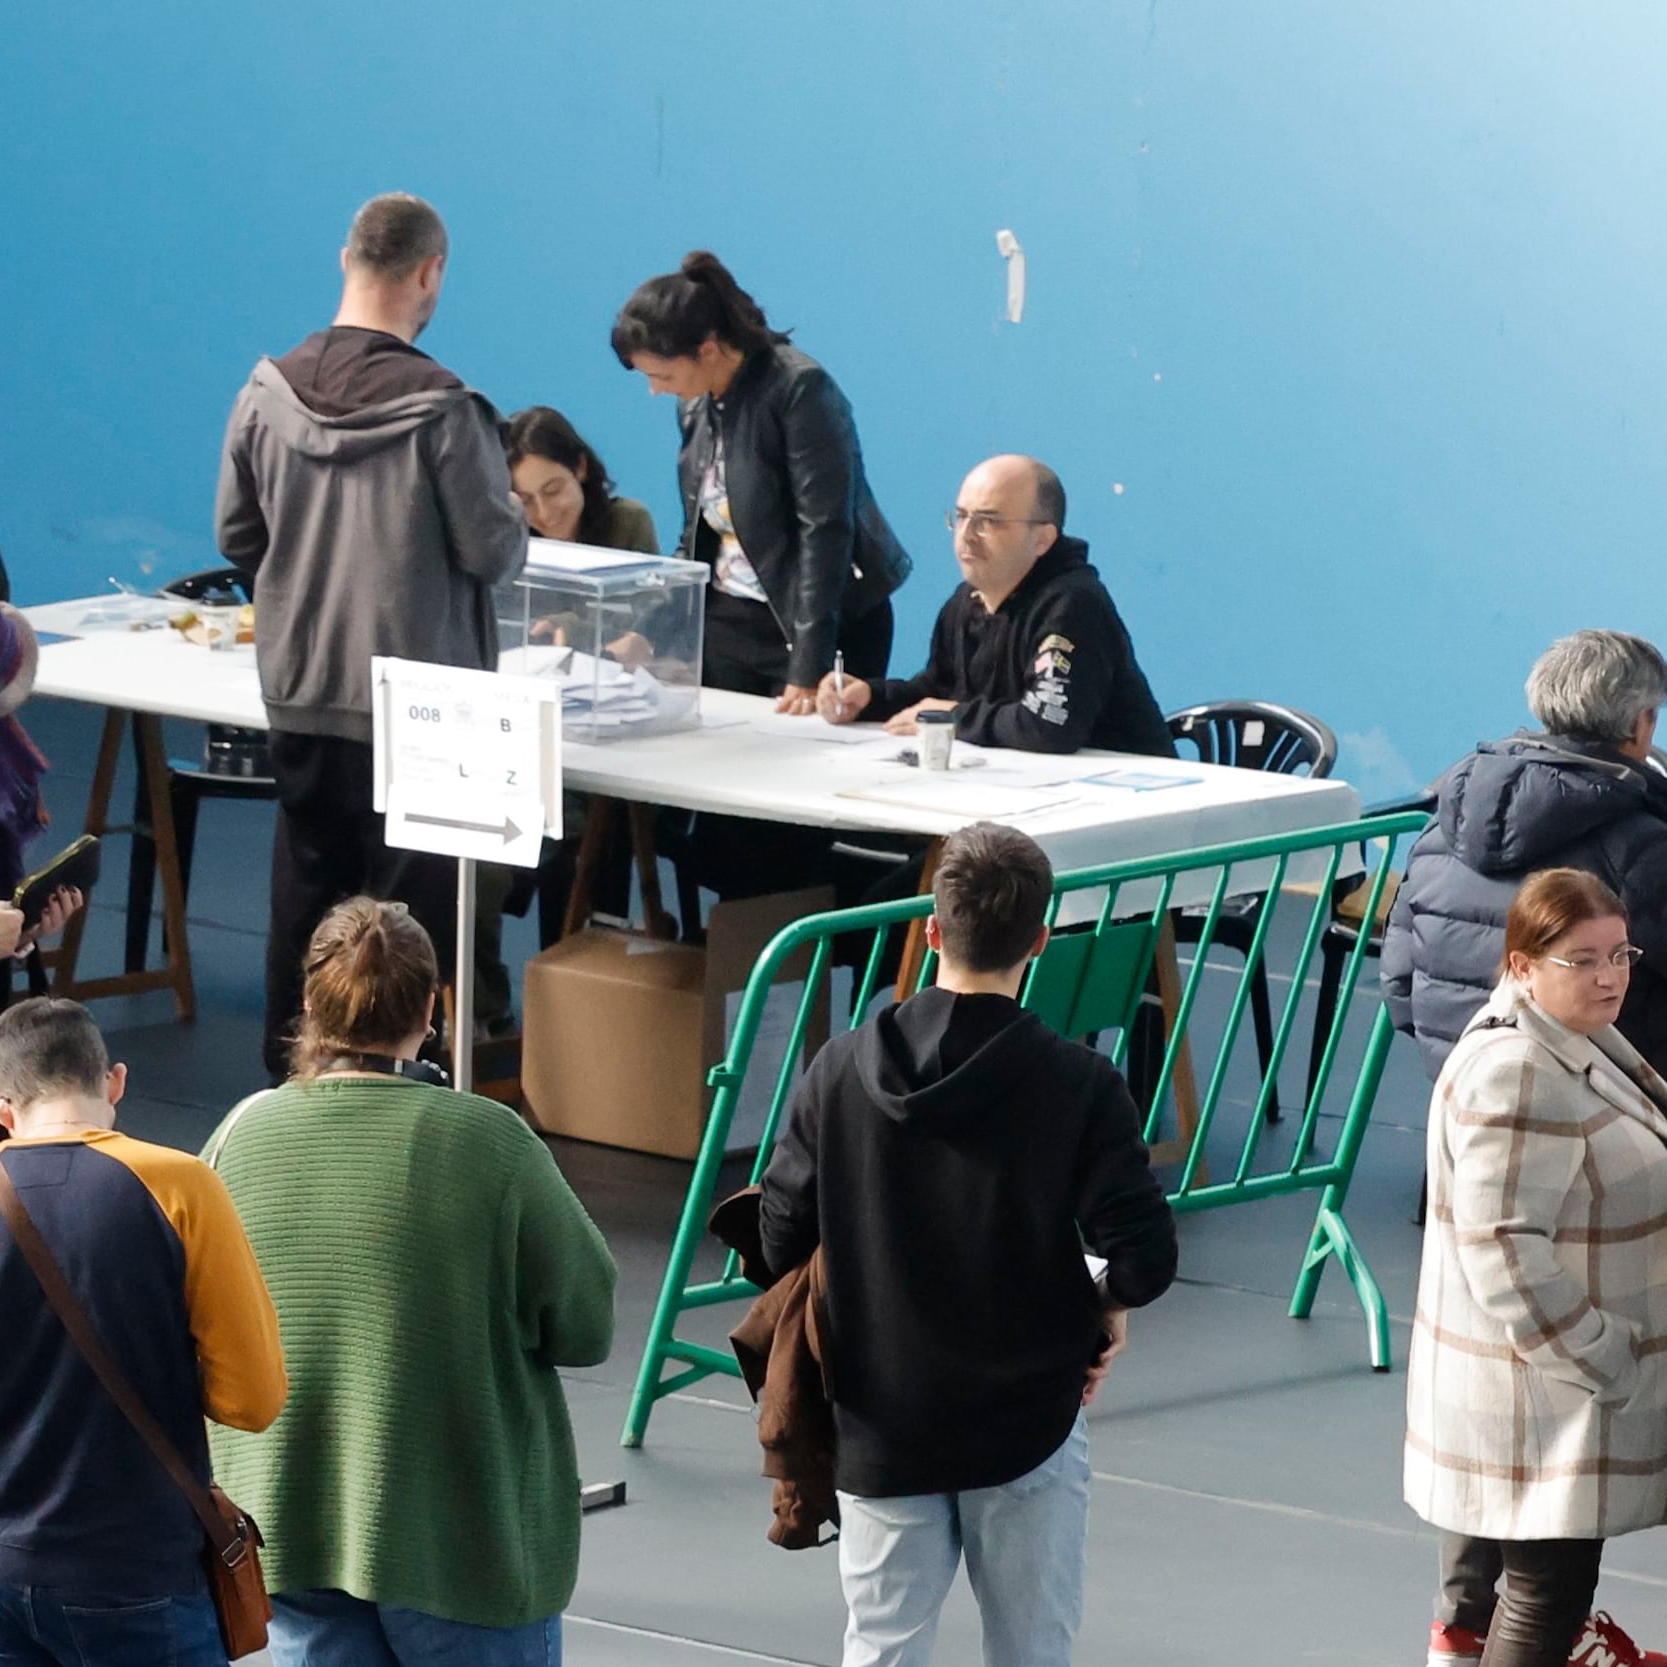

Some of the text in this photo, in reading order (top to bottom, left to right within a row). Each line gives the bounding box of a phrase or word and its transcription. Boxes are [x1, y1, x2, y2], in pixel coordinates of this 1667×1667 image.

[408, 705, 441, 723] 008
[500, 718, 512, 733] B
[458, 763, 469, 778] L
[506, 770, 517, 786] Z
